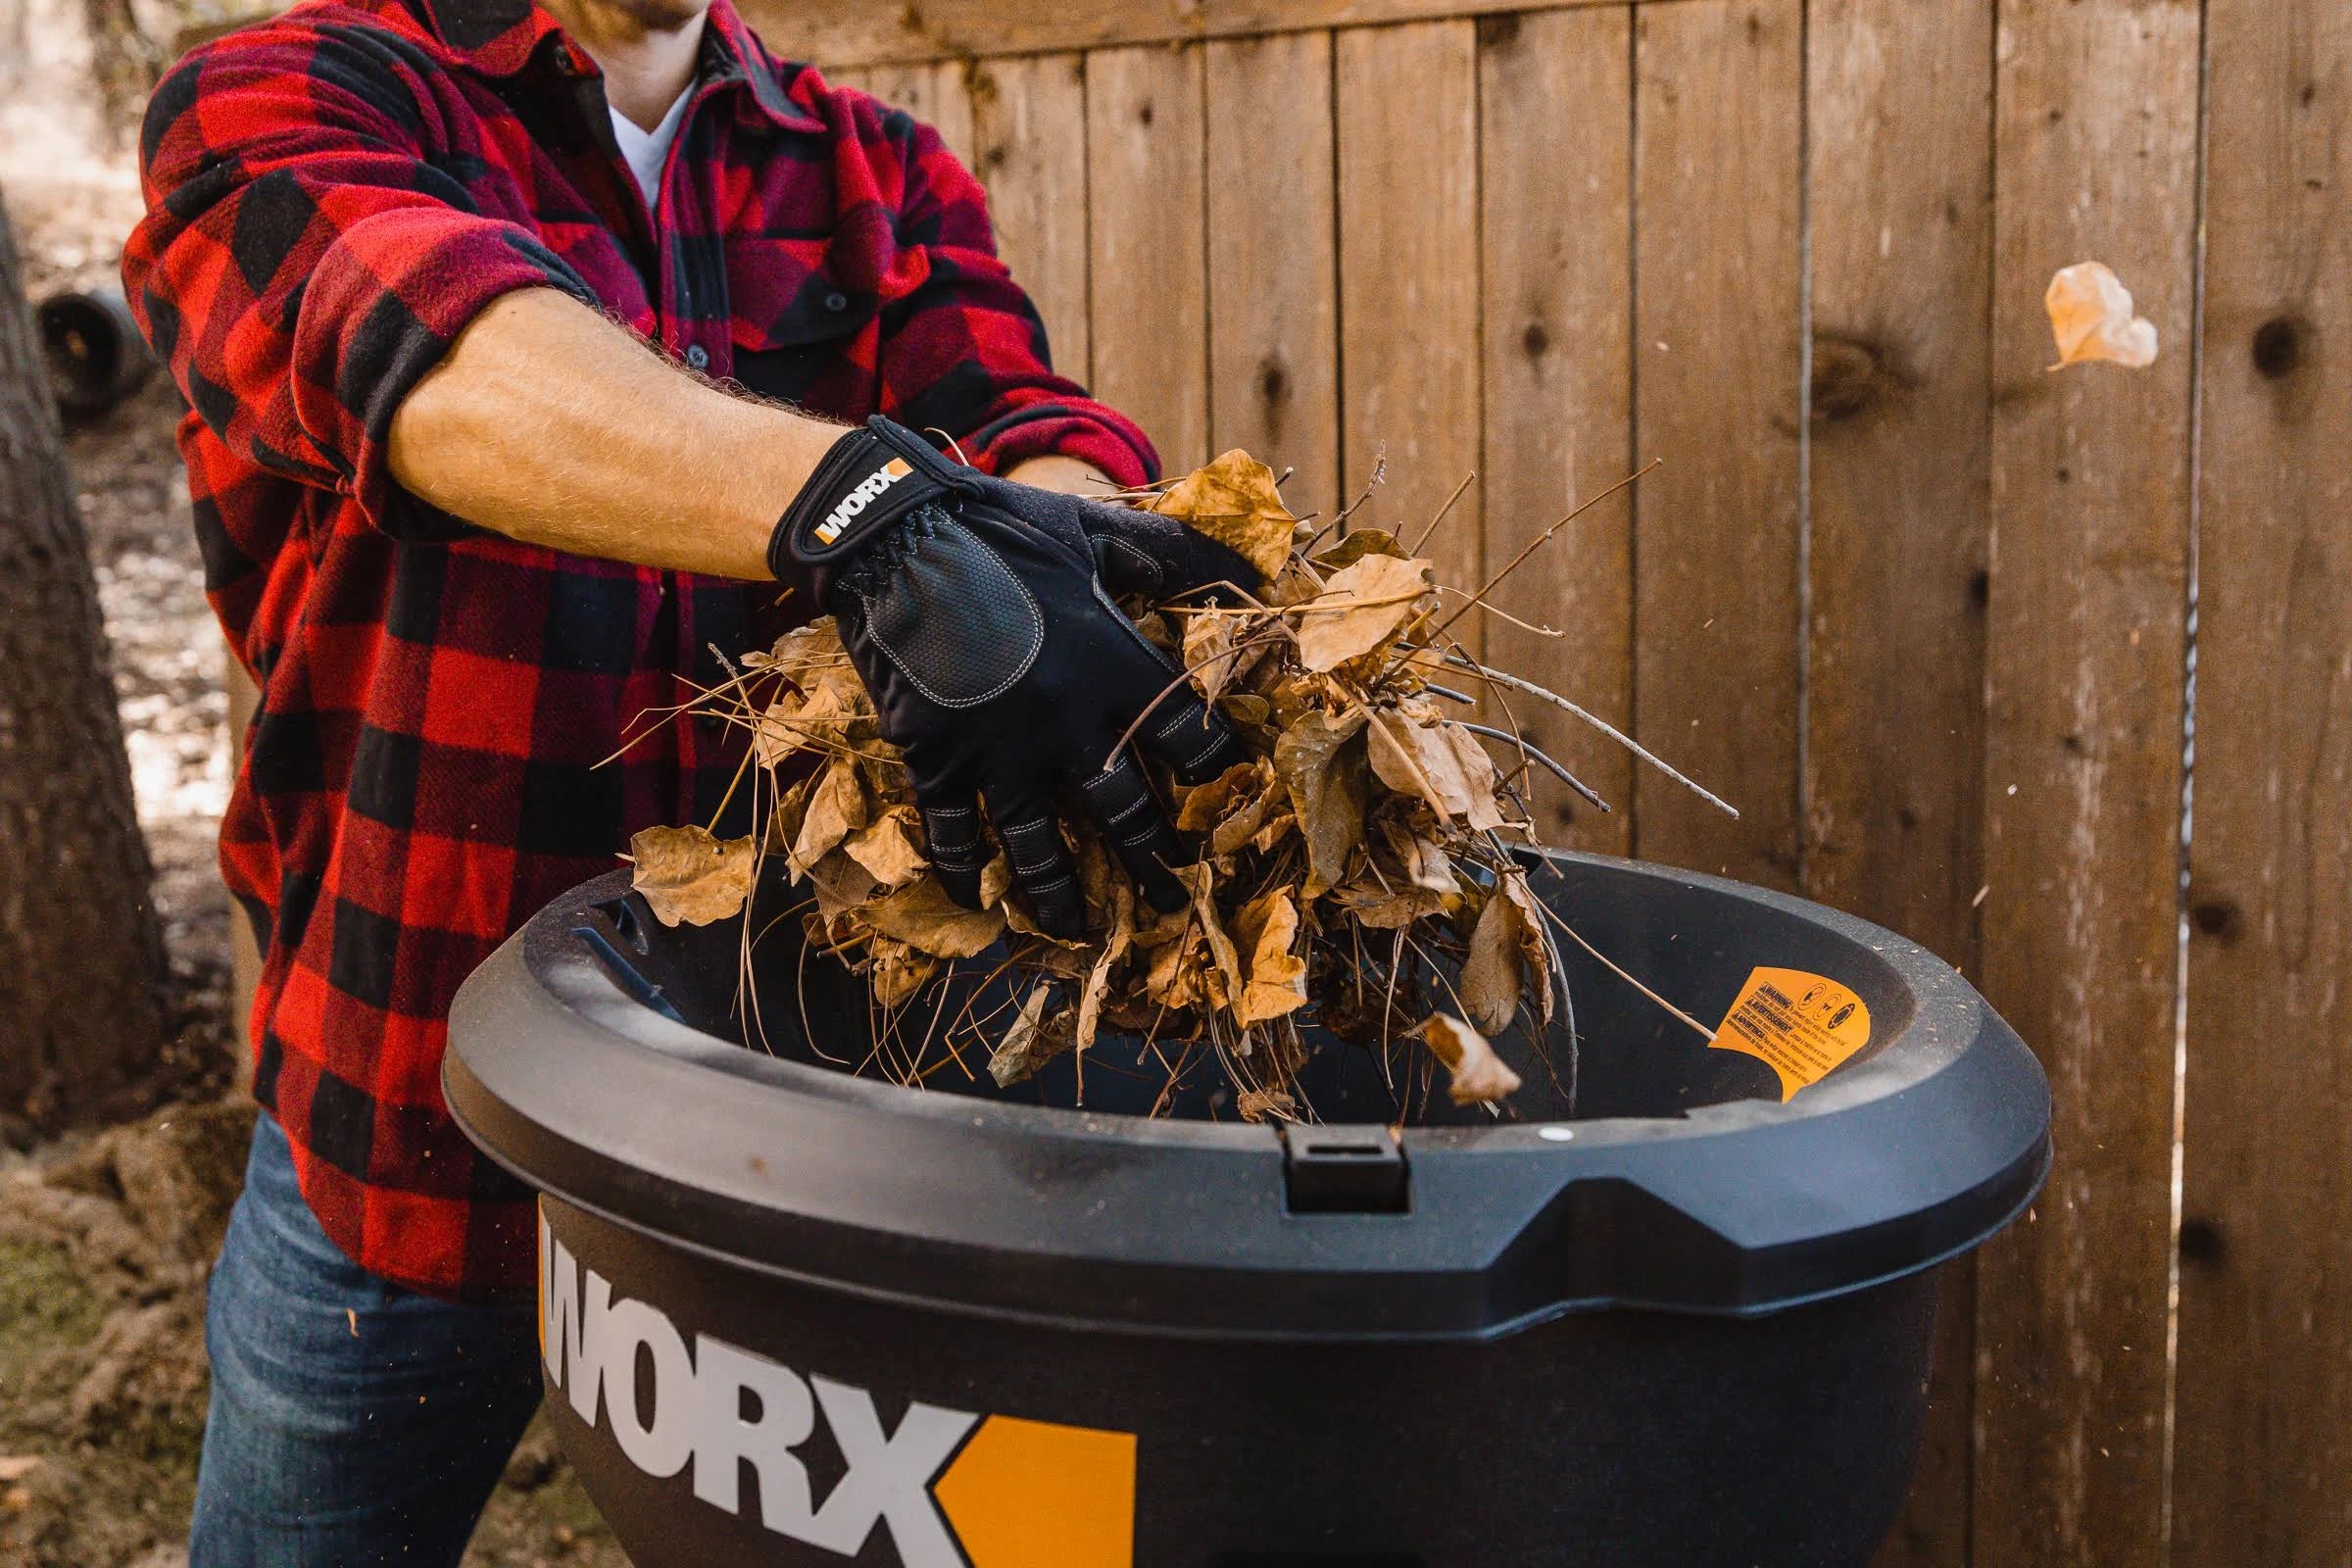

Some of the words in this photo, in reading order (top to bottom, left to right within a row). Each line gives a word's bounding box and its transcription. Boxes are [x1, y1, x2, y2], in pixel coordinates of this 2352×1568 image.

[817, 465, 906, 539] WORX
[1766, 986, 1792, 1009] WARNING
[542, 1215, 980, 1568] WORX
